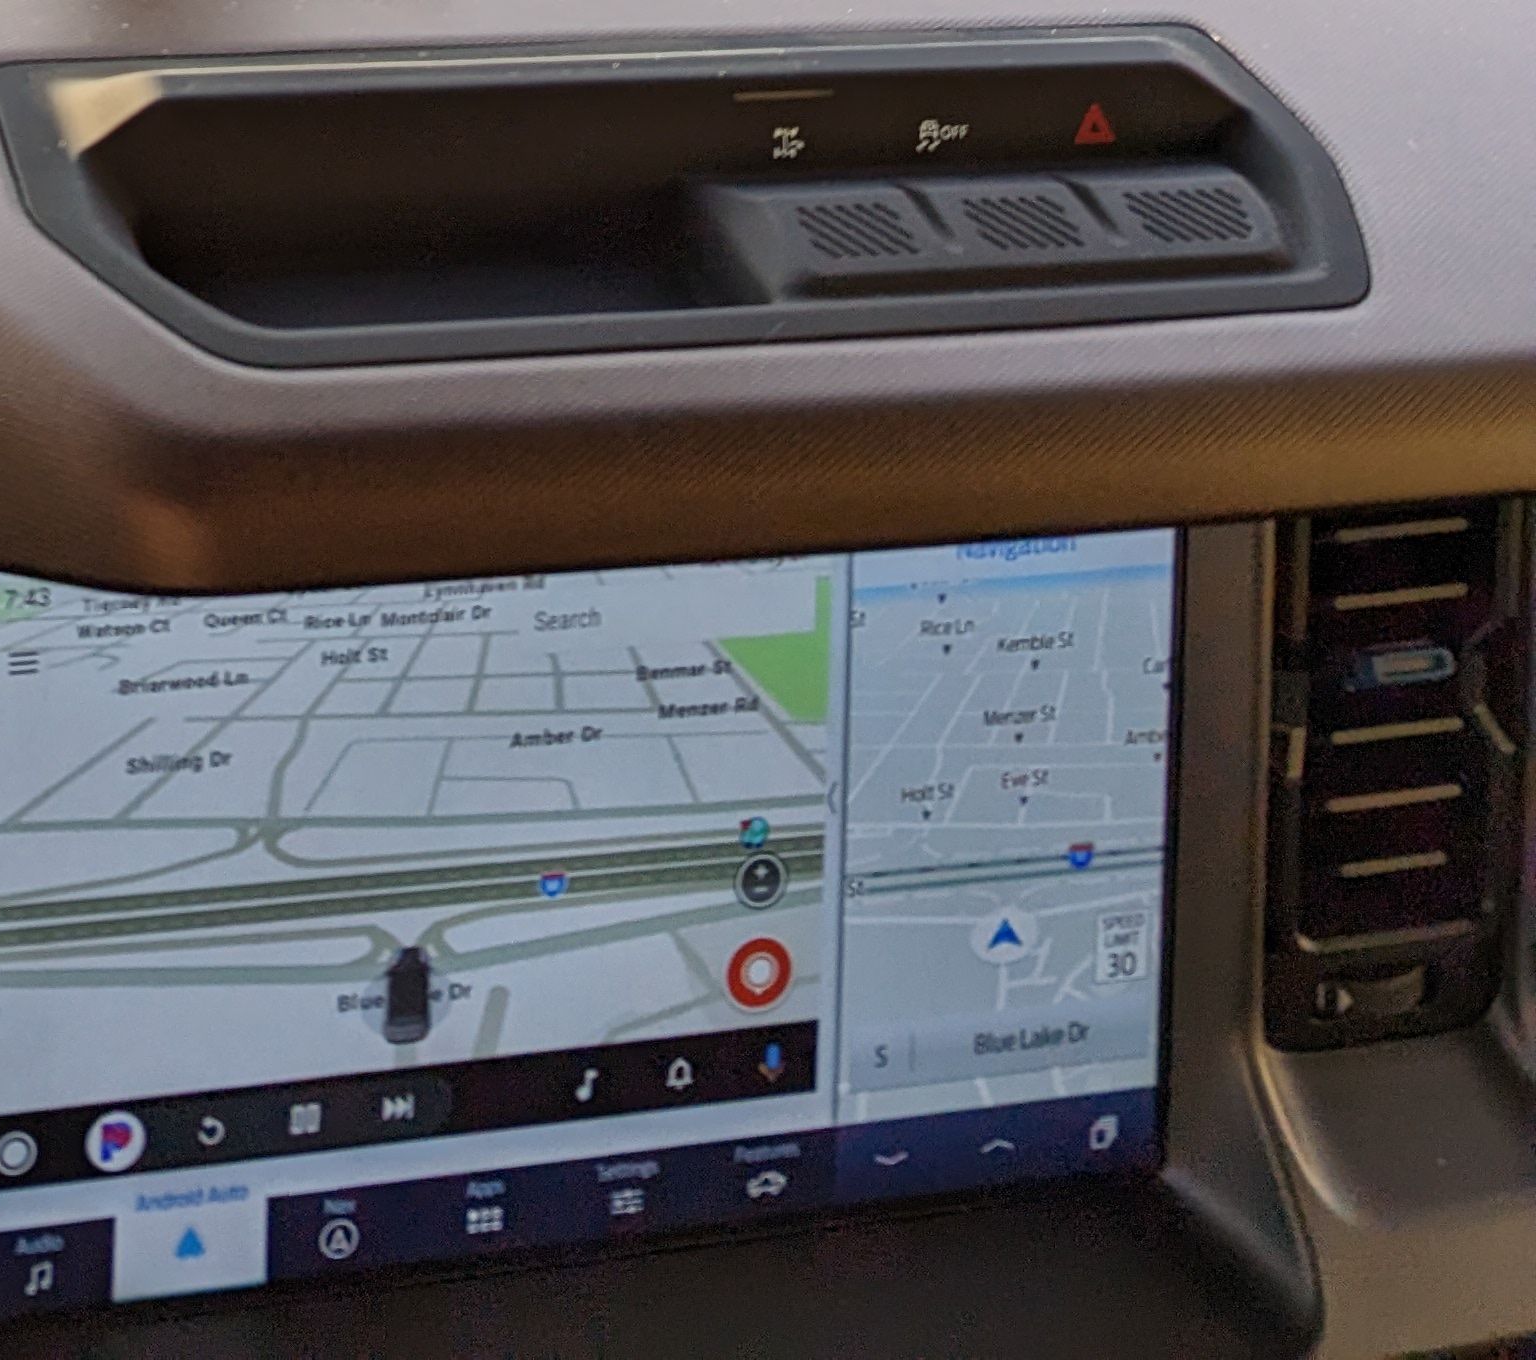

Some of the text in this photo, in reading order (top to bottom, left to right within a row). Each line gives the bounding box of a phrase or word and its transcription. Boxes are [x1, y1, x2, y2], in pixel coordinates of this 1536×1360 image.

[5, 587, 51, 609] 7:43
[472, 604, 492, 620] Dr
[534, 608, 602, 631] Search
[509, 724, 603, 749] Amber Dr
[209, 749, 232, 768] Dr
[1103, 913, 1145, 929] SPEED
[1107, 951, 1137, 978] 30
[448, 982, 471, 1001] Dr
[974, 1020, 1090, 1055] Blue Lake Dr
[874, 1044, 888, 1068] S
[135, 1184, 249, 1211] Android Auto
